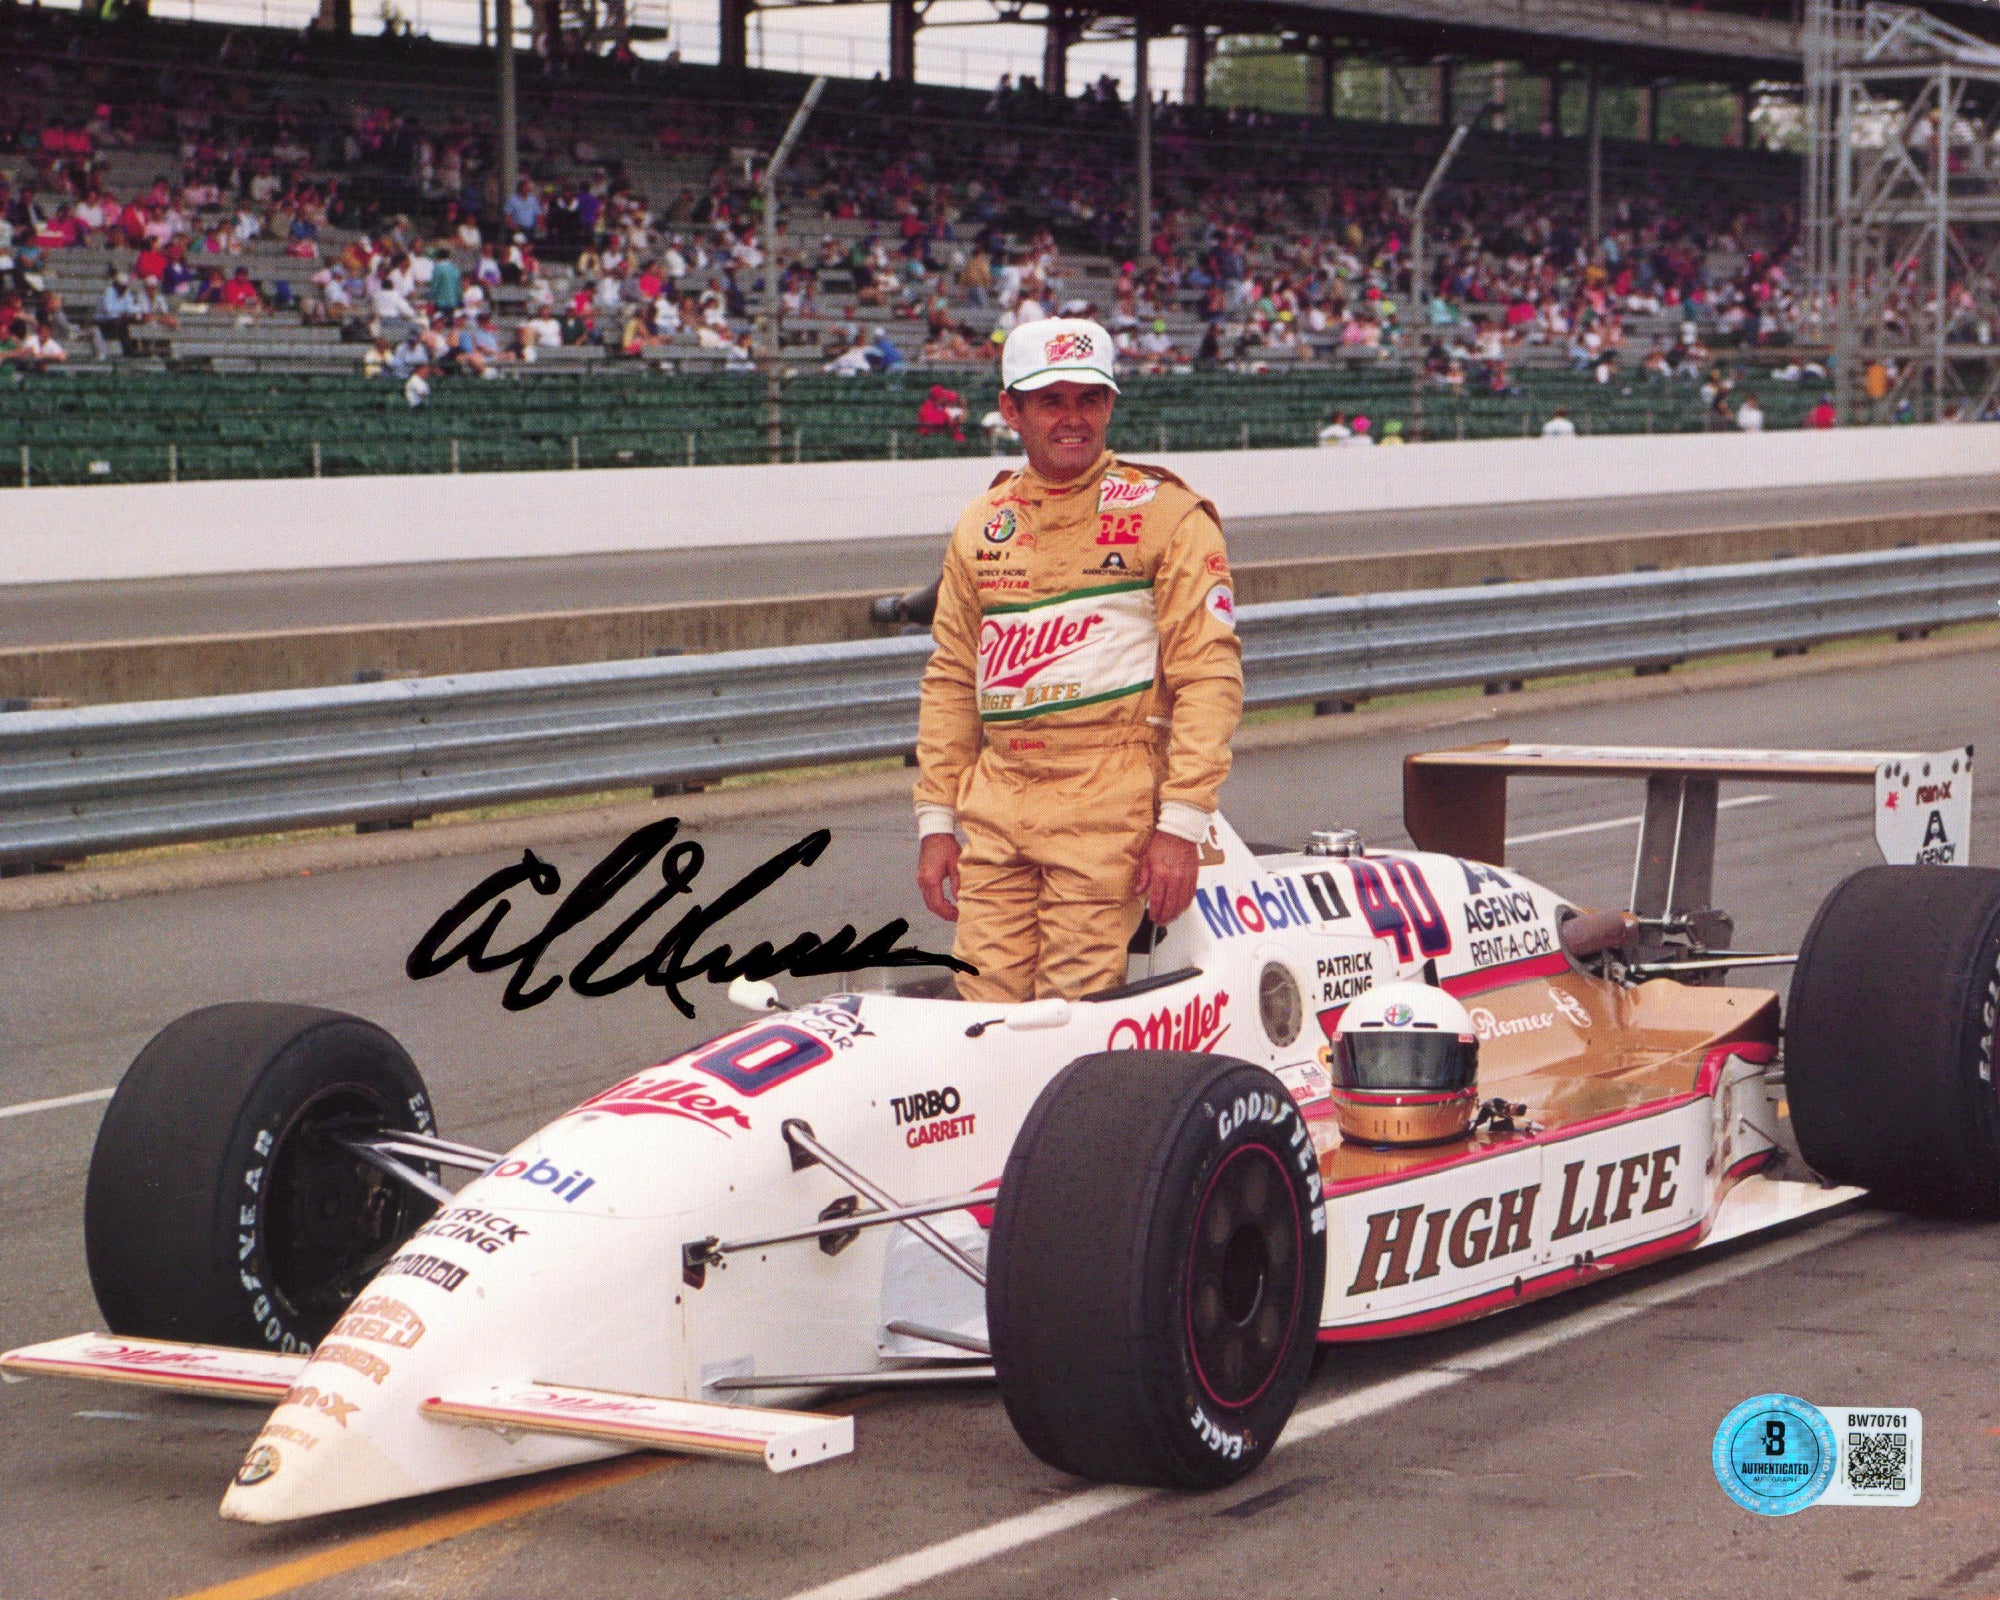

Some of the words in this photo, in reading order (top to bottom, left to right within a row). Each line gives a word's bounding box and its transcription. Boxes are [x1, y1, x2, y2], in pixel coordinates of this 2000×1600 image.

[979, 614, 1104, 684] Miller
[1023, 682, 1081, 706] LIFE
[1196, 876, 1311, 939] Mobil
[1308, 873, 1343, 919] 1
[1345, 855, 1452, 964] 40
[1464, 890, 1540, 933] AGENCY
[1316, 952, 1373, 978] PATRICK
[1470, 927, 1552, 966] RENT-A-CAR
[1323, 975, 1373, 1002] RACING
[1106, 989, 1230, 1053] Miller
[1470, 1007, 1555, 1041] Romeo
[582, 1077, 752, 1129] iller
[890, 1086, 961, 1126] TURBO
[906, 1114, 976, 1149] GARRETT
[481, 1157, 596, 1203] obil
[1218, 1091, 1328, 1235] GOODYEAR
[411, 1223, 506, 1254] ACING
[433, 1208, 530, 1243] TRICK
[1346, 1183, 1541, 1297] HIGH
[1551, 1144, 1681, 1241] LIFE
[309, 1344, 391, 1386] EBER
[1190, 1405, 1243, 1460] EAGLE
